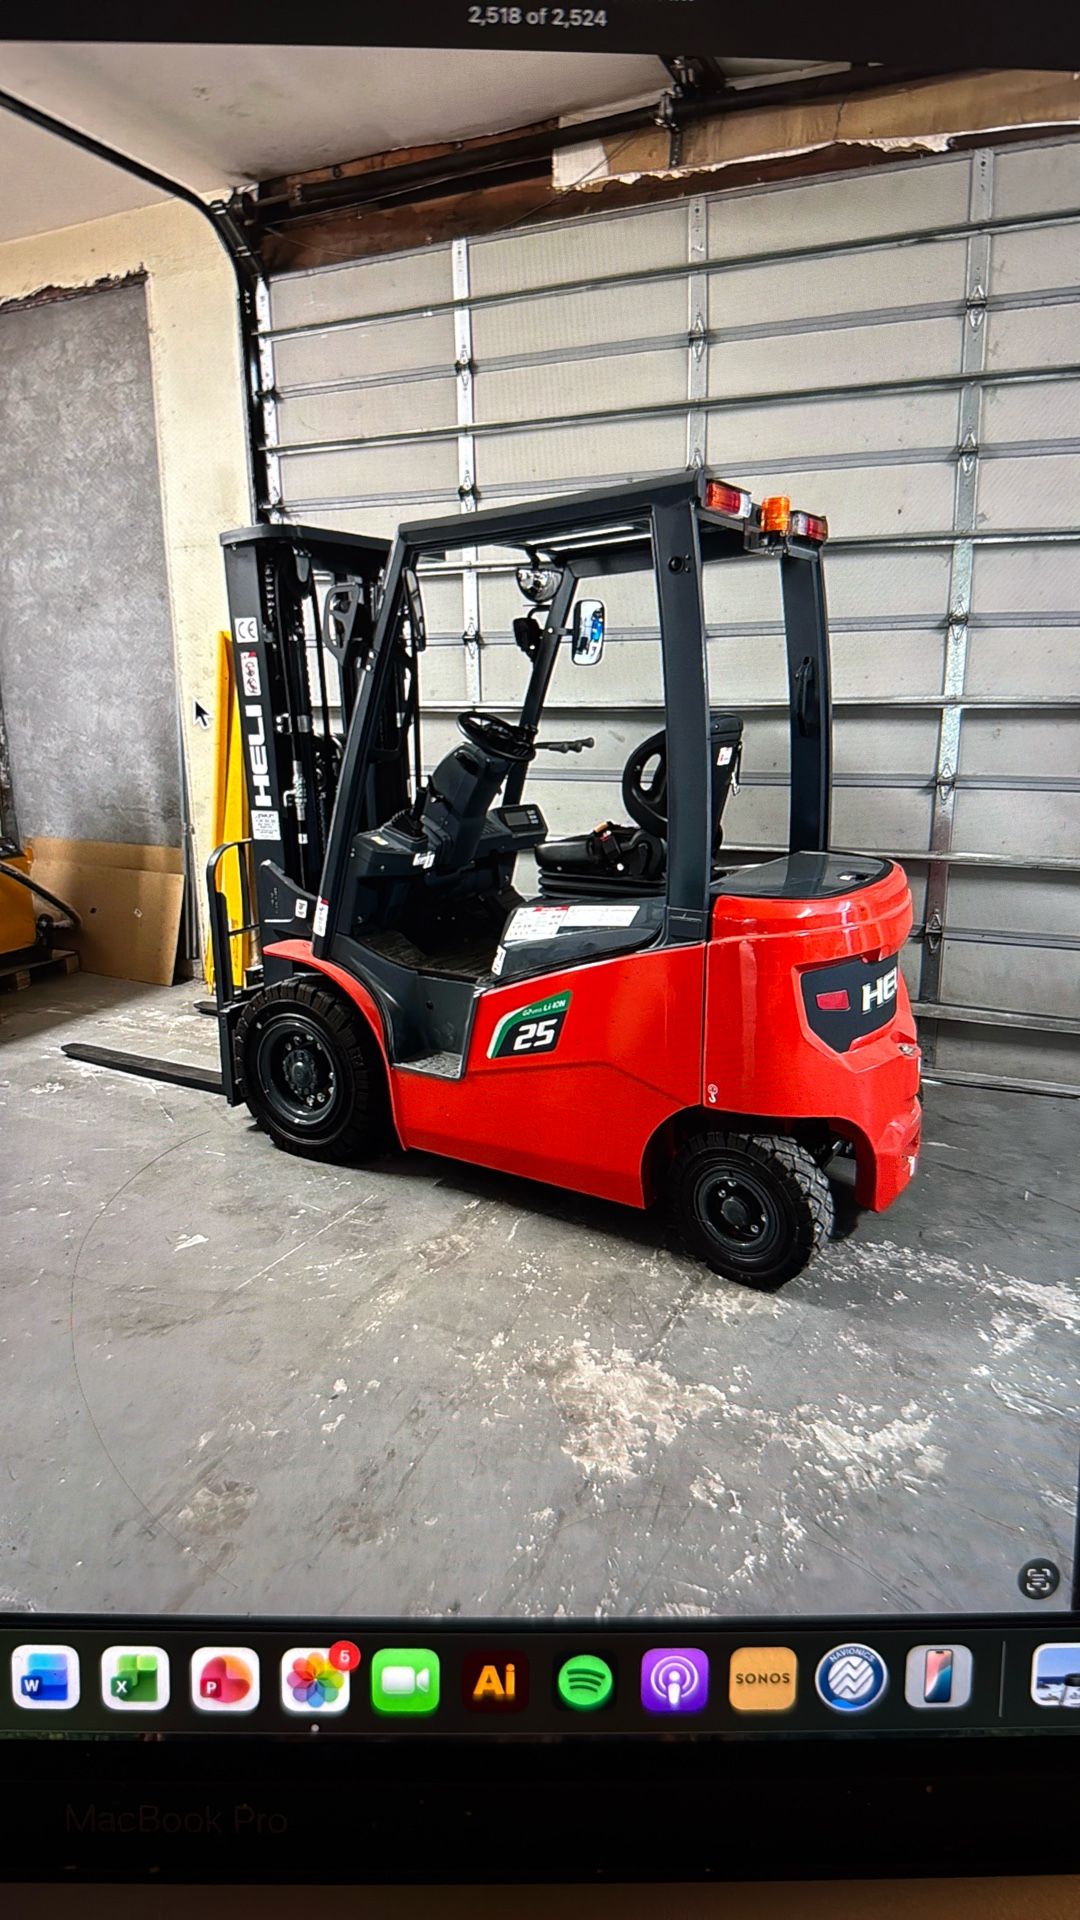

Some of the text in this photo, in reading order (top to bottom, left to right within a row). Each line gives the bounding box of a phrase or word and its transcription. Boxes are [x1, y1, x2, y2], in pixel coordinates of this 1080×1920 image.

[468, 6, 608, 28] 2,518 of 2,524
[238, 621, 256, 639] CE
[245, 704, 273, 807] HELI
[513, 1018, 558, 1051] 25
[340, 1649, 350, 1663] 5
[829, 1647, 876, 1663] NAVIONICS
[23, 1680, 39, 1694] W
[116, 1680, 127, 1694] X
[473, 1663, 516, 1695] Ai
[735, 1672, 790, 1685] SONOS
[206, 1681, 217, 1694] P
[65, 1804, 288, 1833] MacBook Pro
